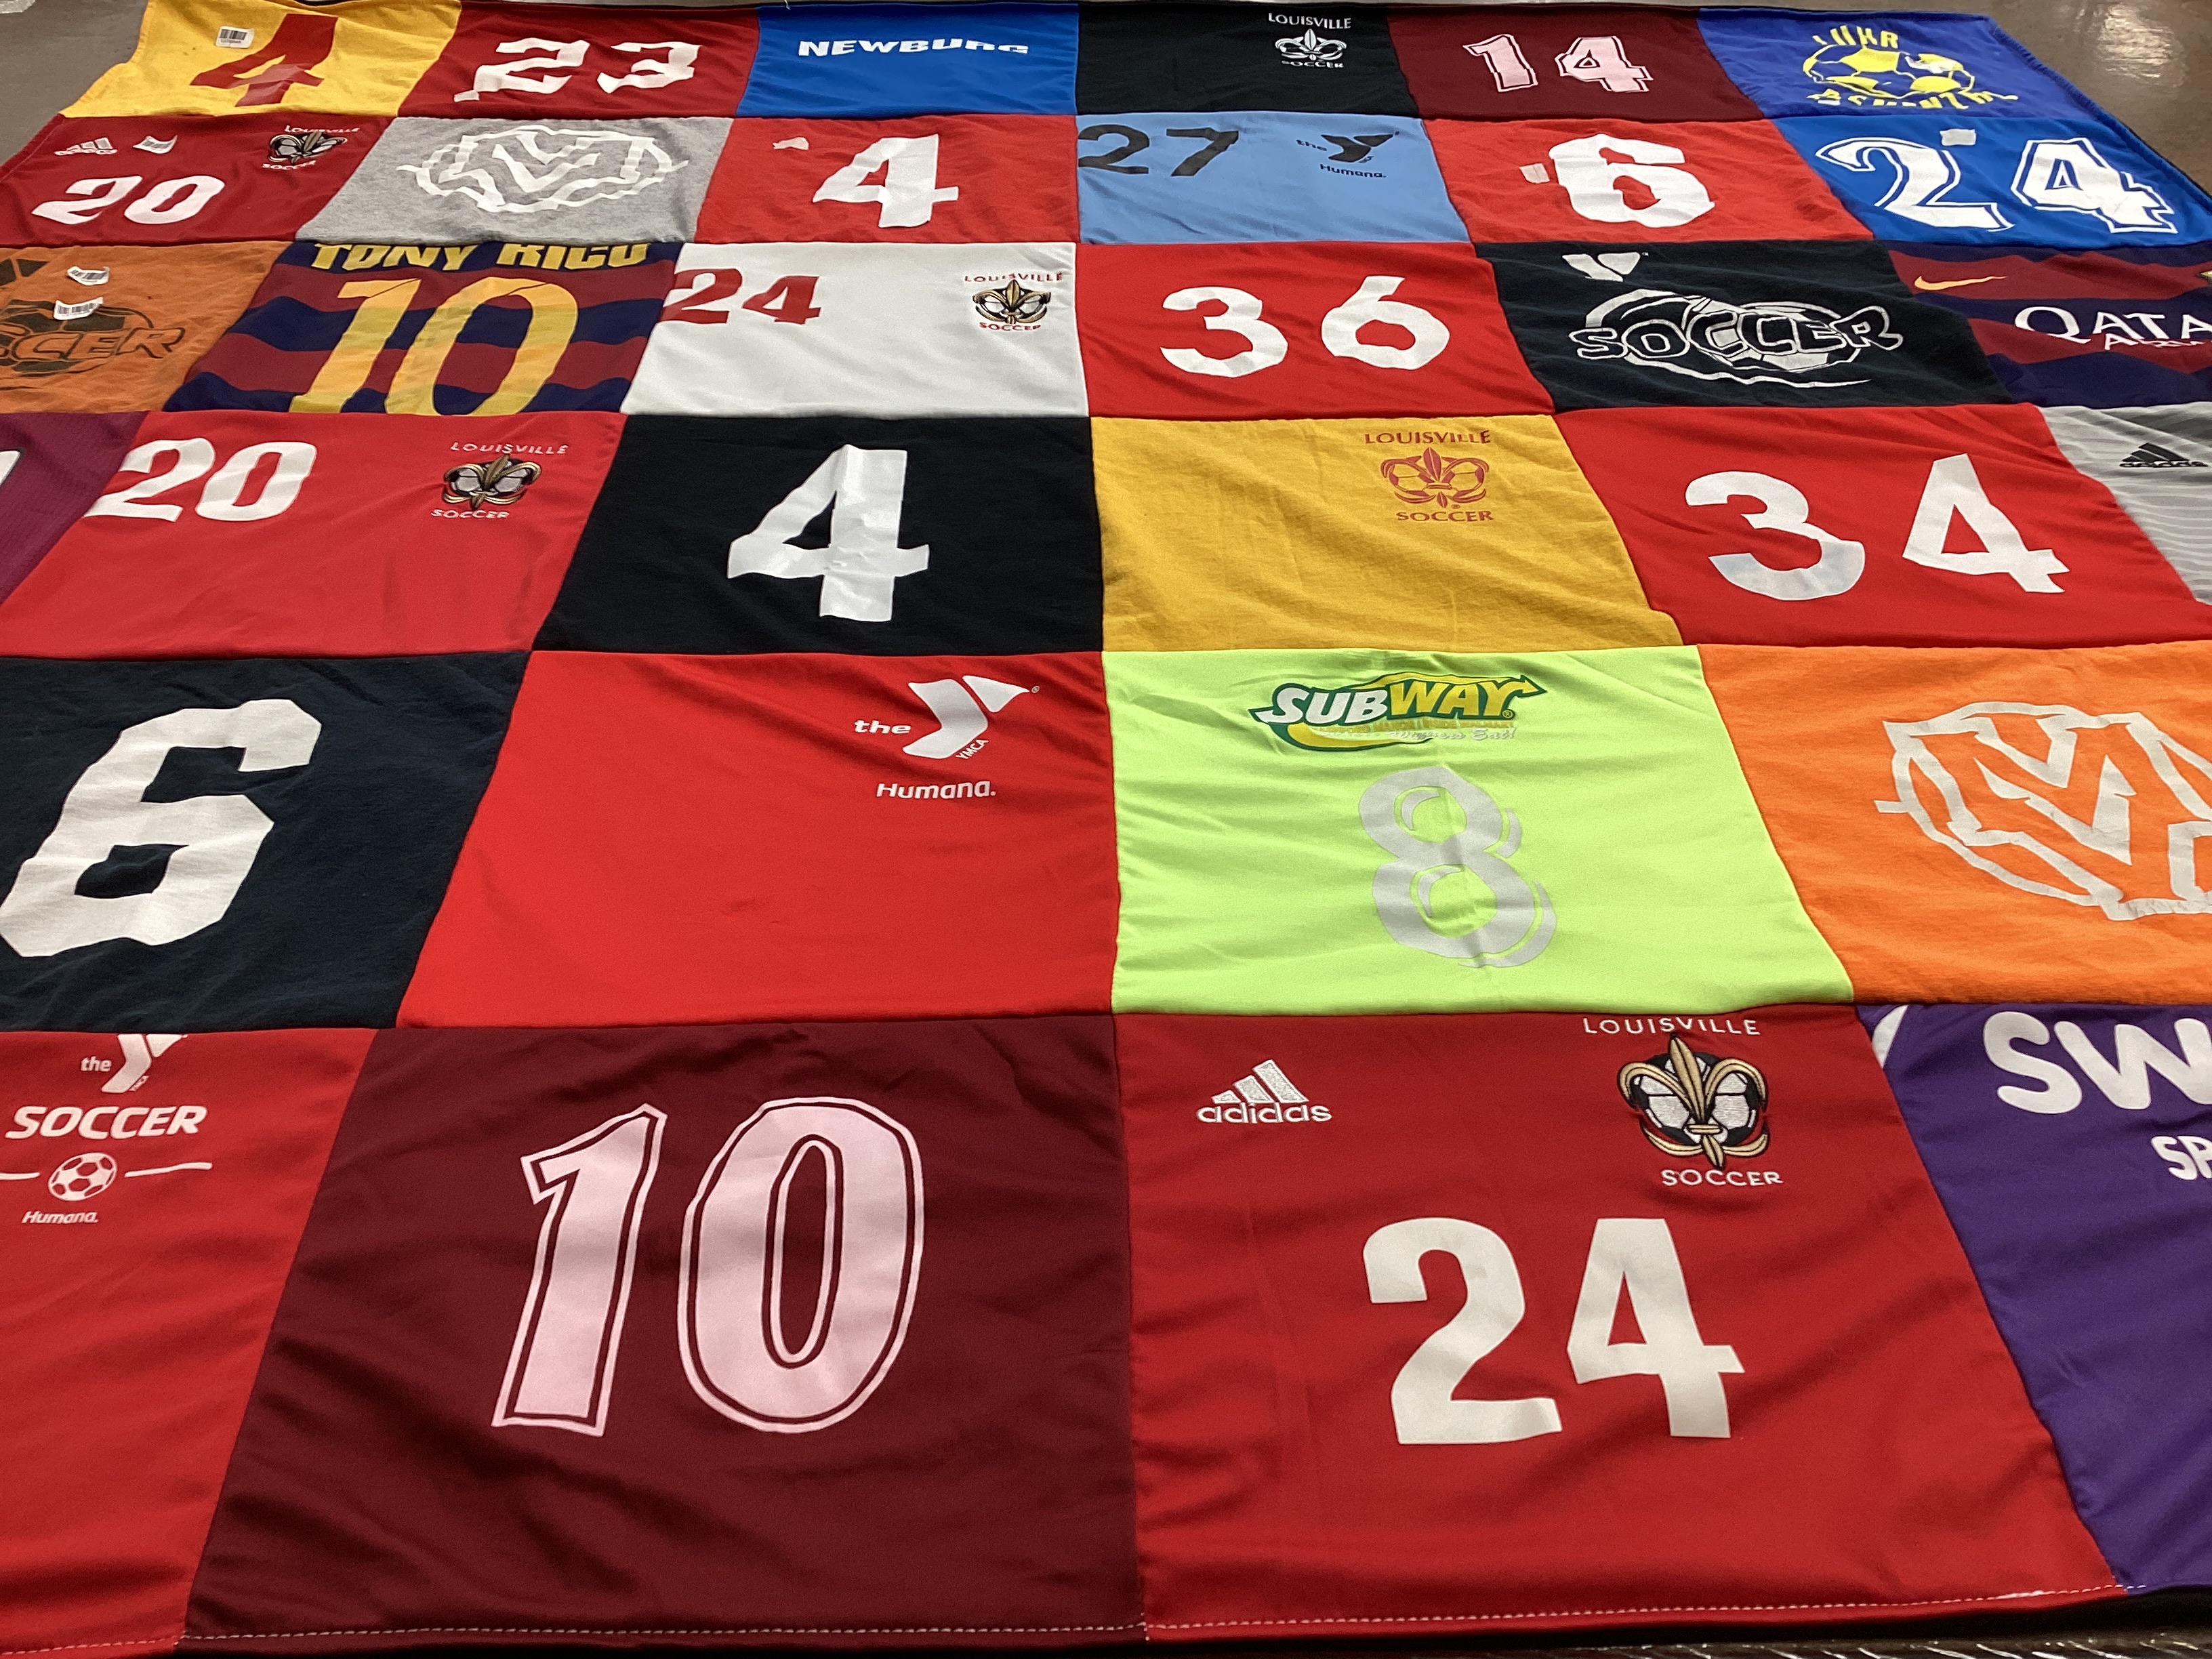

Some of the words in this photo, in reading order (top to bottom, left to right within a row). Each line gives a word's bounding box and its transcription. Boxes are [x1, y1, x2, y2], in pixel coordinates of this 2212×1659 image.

[1269, 12, 1351, 29] LOUISVILLE
[190, 14, 338, 107] 4
[453, 37, 702, 102] 23
[798, 39, 1029, 56] NEWBURG
[1463, 34, 1654, 93] 14
[1078, 124, 1240, 176] 27
[32, 175, 225, 225] 20
[813, 134, 959, 228] 4
[1549, 134, 1715, 228] 6
[1815, 137, 2178, 234] 24
[310, 243, 478, 271] TONY
[964, 272, 1063, 283] LOUISVILLE
[659, 268, 820, 325] 24
[289, 276, 579, 416] 10
[1160, 275, 1450, 377] 36
[1568, 306, 1903, 360] SOCCER
[450, 442, 569, 455] LOUISVILLE
[1364, 430, 1491, 444] LOUISVILLE
[83, 437, 317, 522] 20
[430, 509, 510, 518] SOCCER
[728, 444, 929, 621] 4
[1396, 510, 1494, 522] SOCCER
[1685, 453, 2071, 601] 34
[854, 720, 912, 734] the
[1256, 679, 1540, 724] SUBWAY
[955, 739, 989, 759] YMCA
[876, 781, 996, 799] Humana.
[0, 699, 322, 958] 6
[1359, 764, 1557, 968] 8
[1582, 1017, 1761, 1036] LOUISVILLE
[81, 1056, 112, 1071] the
[5, 1105, 207, 1139] SOCCER
[1196, 1102, 1332, 1124] adidas
[1661, 1169, 1784, 1186] SOCCER
[491, 1096, 924, 1437] 10
[1363, 1217, 1745, 1444] 24
